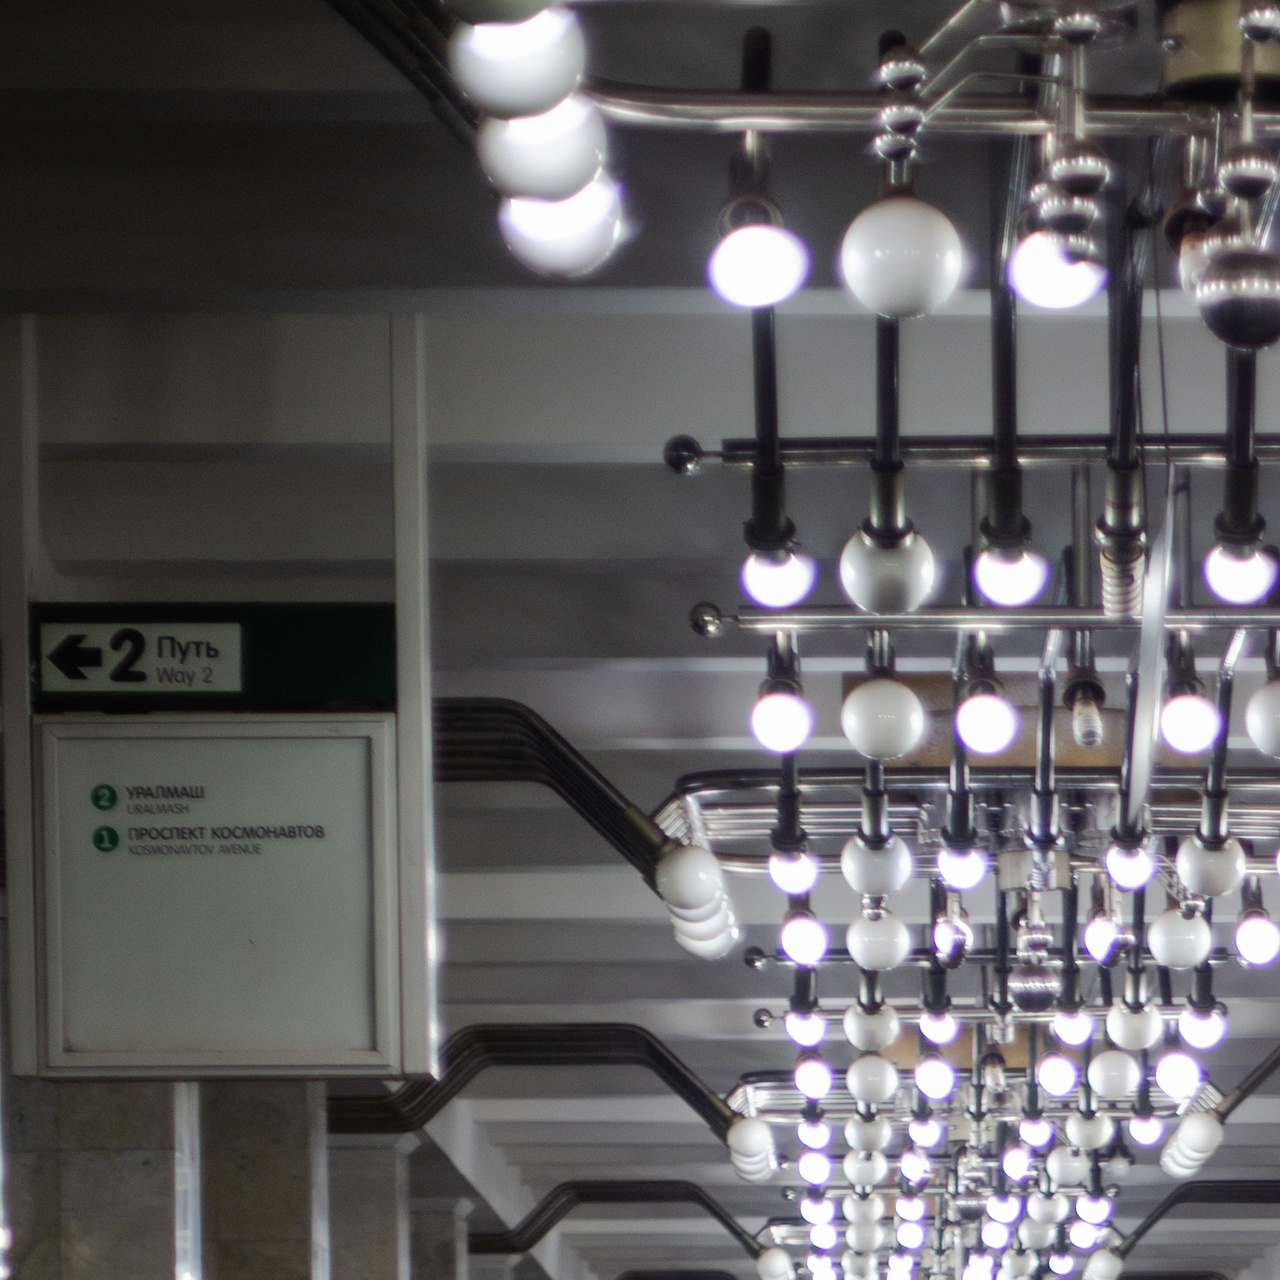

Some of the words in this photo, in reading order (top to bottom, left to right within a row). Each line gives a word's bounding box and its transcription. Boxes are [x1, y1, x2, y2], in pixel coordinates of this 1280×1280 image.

[109, 628, 147, 682] 2
[157, 636, 220, 663] Путь
[157, 667, 195, 686] Way
[202, 668, 213, 683] 2
[126, 786, 205, 799] УРАЛМАШ
[128, 827, 205, 841] ПРОСПЕКТ
[211, 825, 325, 840] КОСМОНАВТОВ
